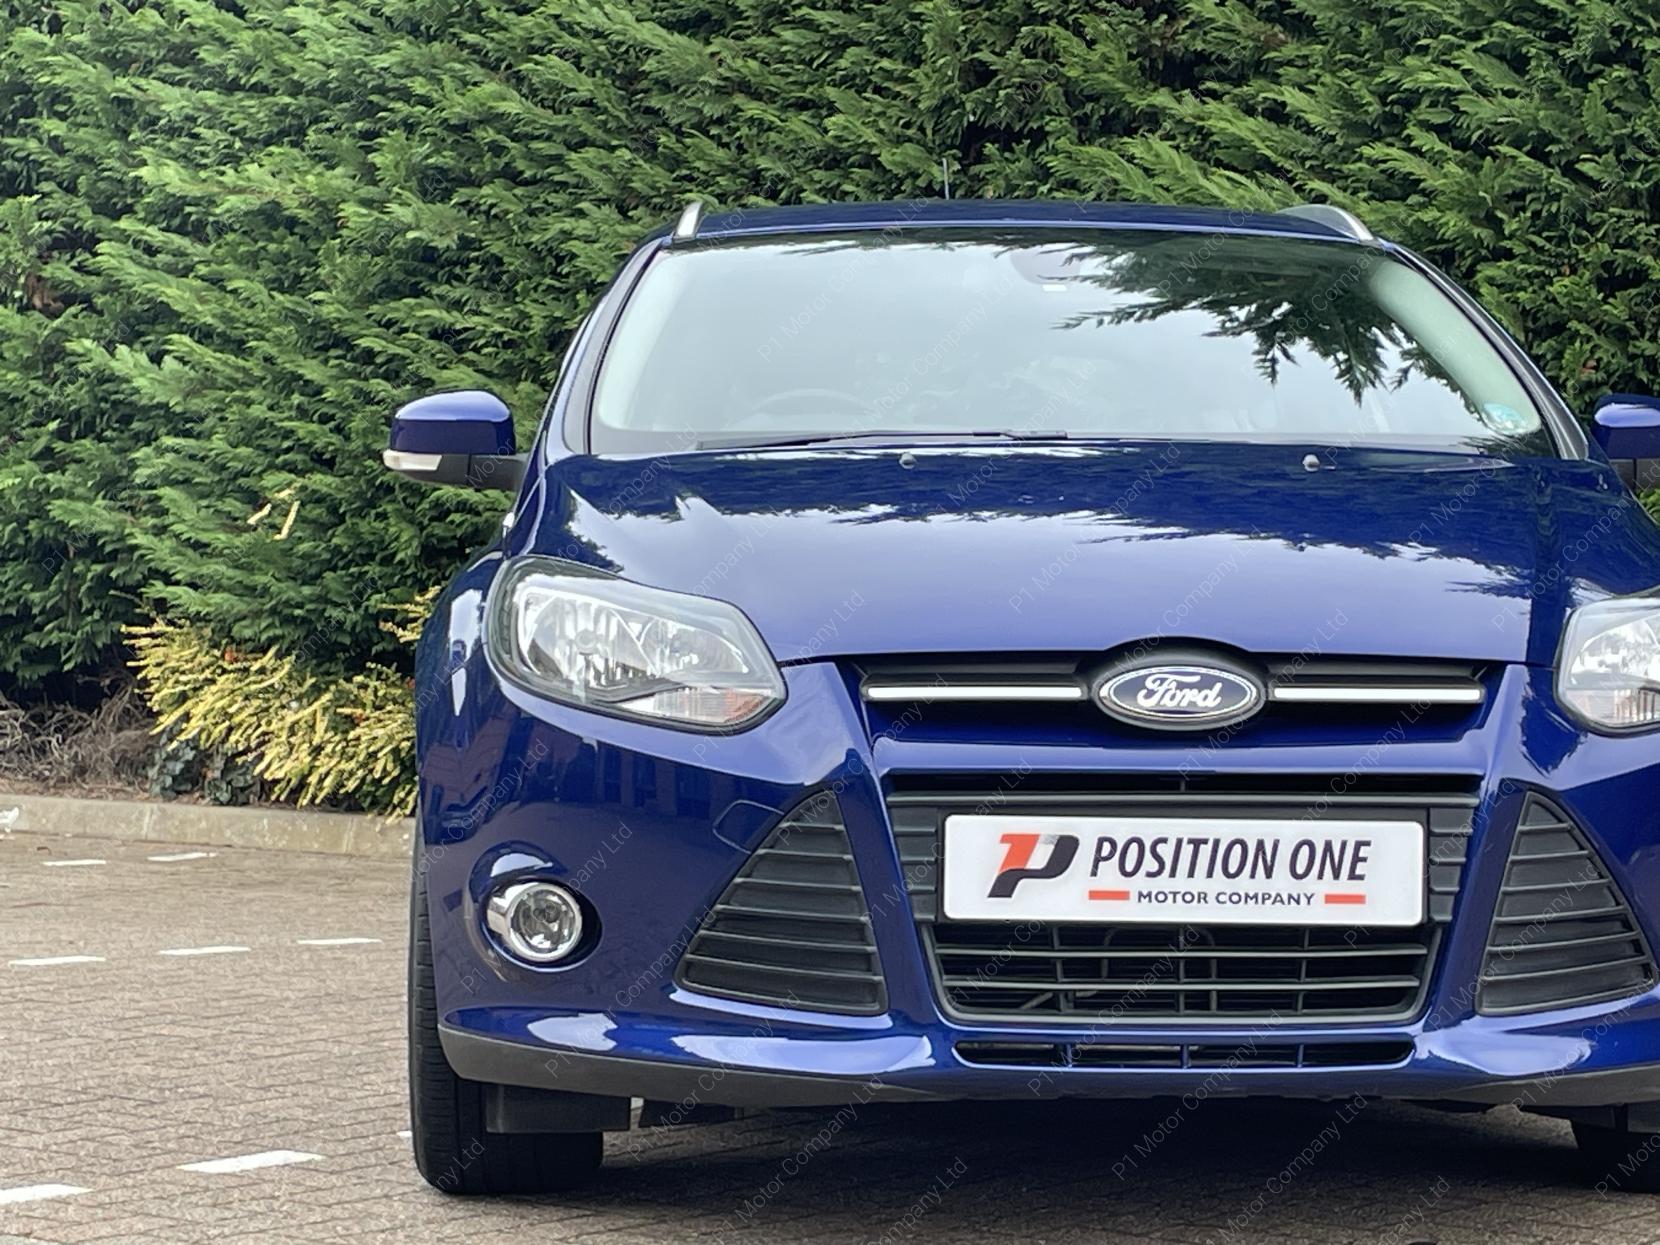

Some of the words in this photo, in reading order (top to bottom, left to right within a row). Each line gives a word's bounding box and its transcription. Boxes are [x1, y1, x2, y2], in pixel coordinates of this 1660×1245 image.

[1136, 674, 1223, 707] Ford
[1089, 836, 1280, 880] POSITION
[1289, 838, 1372, 881] ONE
[1138, 890, 1208, 904] MOTOR
[1215, 891, 1316, 906] COMPANY
